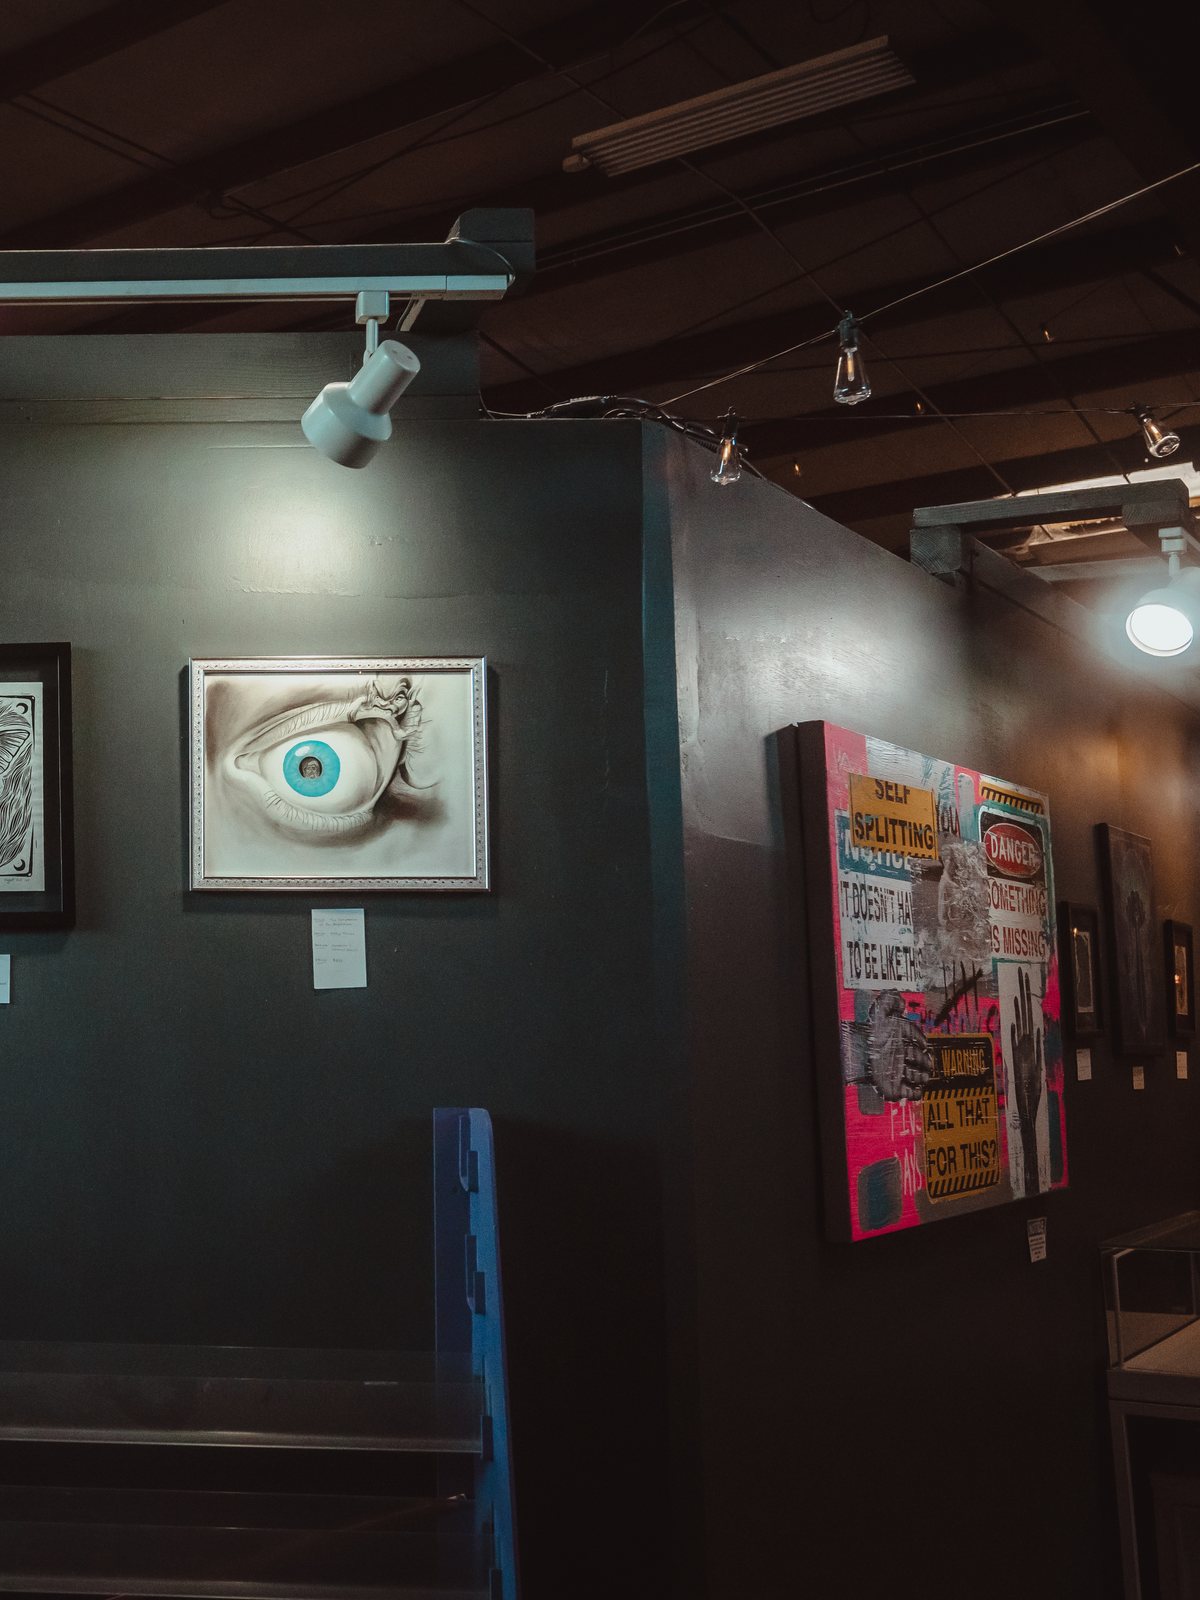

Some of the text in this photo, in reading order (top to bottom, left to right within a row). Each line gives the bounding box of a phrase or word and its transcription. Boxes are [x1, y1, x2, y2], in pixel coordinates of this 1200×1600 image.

[875, 779, 911, 804] SELF
[854, 812, 934, 850] SPLITTING
[990, 832, 1039, 867] DANGER
[986, 877, 1047, 917] SOMETHING
[1002, 927, 1046, 958] MISSING
[847, 941, 862, 979] TO
[863, 942, 878, 980] BE
[879, 944, 902, 981] LIKE
[941, 1048, 986, 1077] WARNING
[927, 1097, 990, 1132] ALL THAT
[927, 1139, 997, 1178] FOR THIS?
